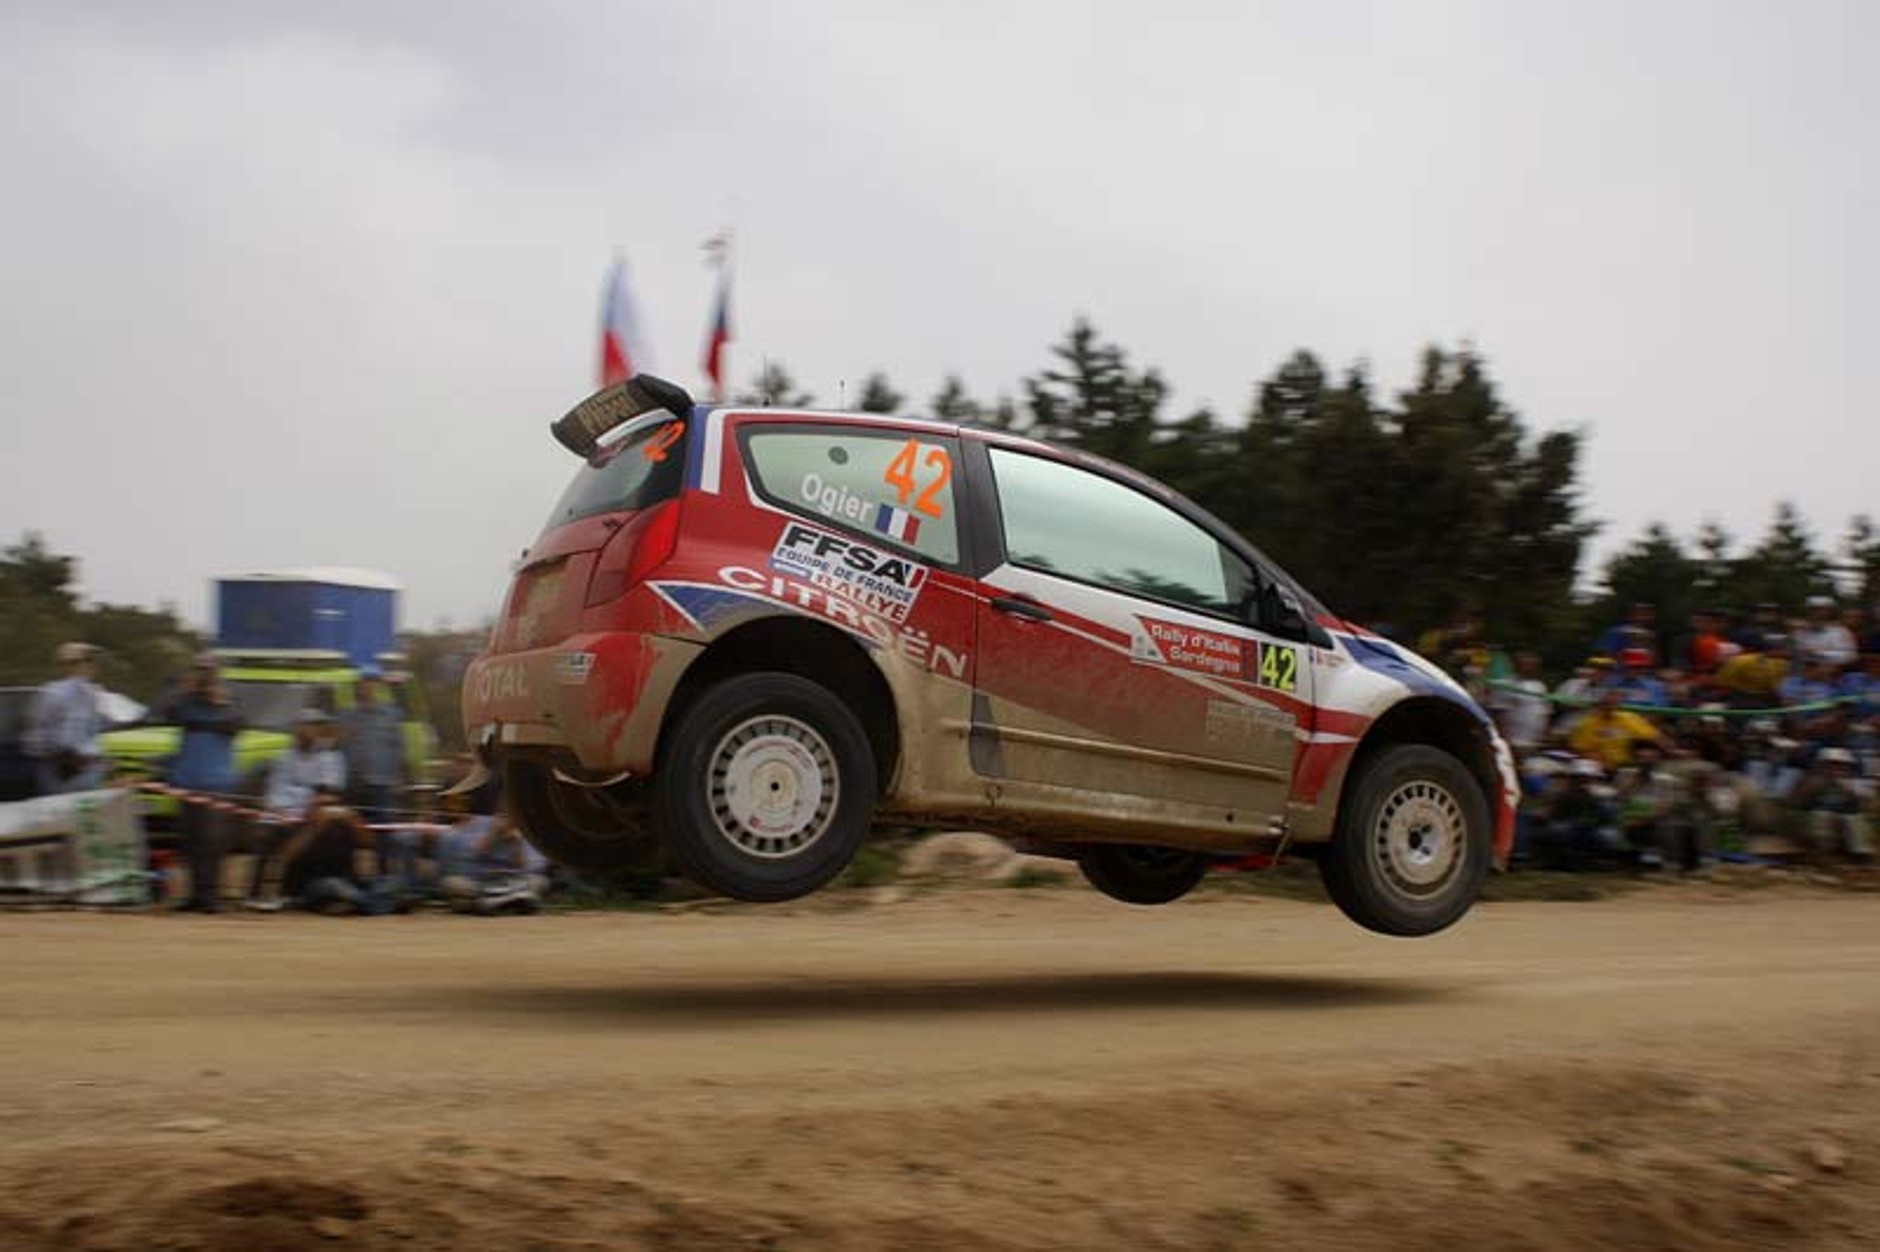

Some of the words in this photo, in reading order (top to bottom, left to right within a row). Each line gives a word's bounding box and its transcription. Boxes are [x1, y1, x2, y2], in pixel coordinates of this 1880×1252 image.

[801, 472, 873, 522] Ogier
[883, 437, 953, 520] 42
[776, 547, 830, 574] EQUIPE
[834, 566, 853, 582] DE
[856, 572, 914, 603] FRANCE
[783, 525, 907, 586] FFSA
[717, 565, 968, 679] CITROËN
[815, 571, 908, 622] RALLYE
[1151, 624, 1188, 648] Rally
[1261, 645, 1297, 692] 42
